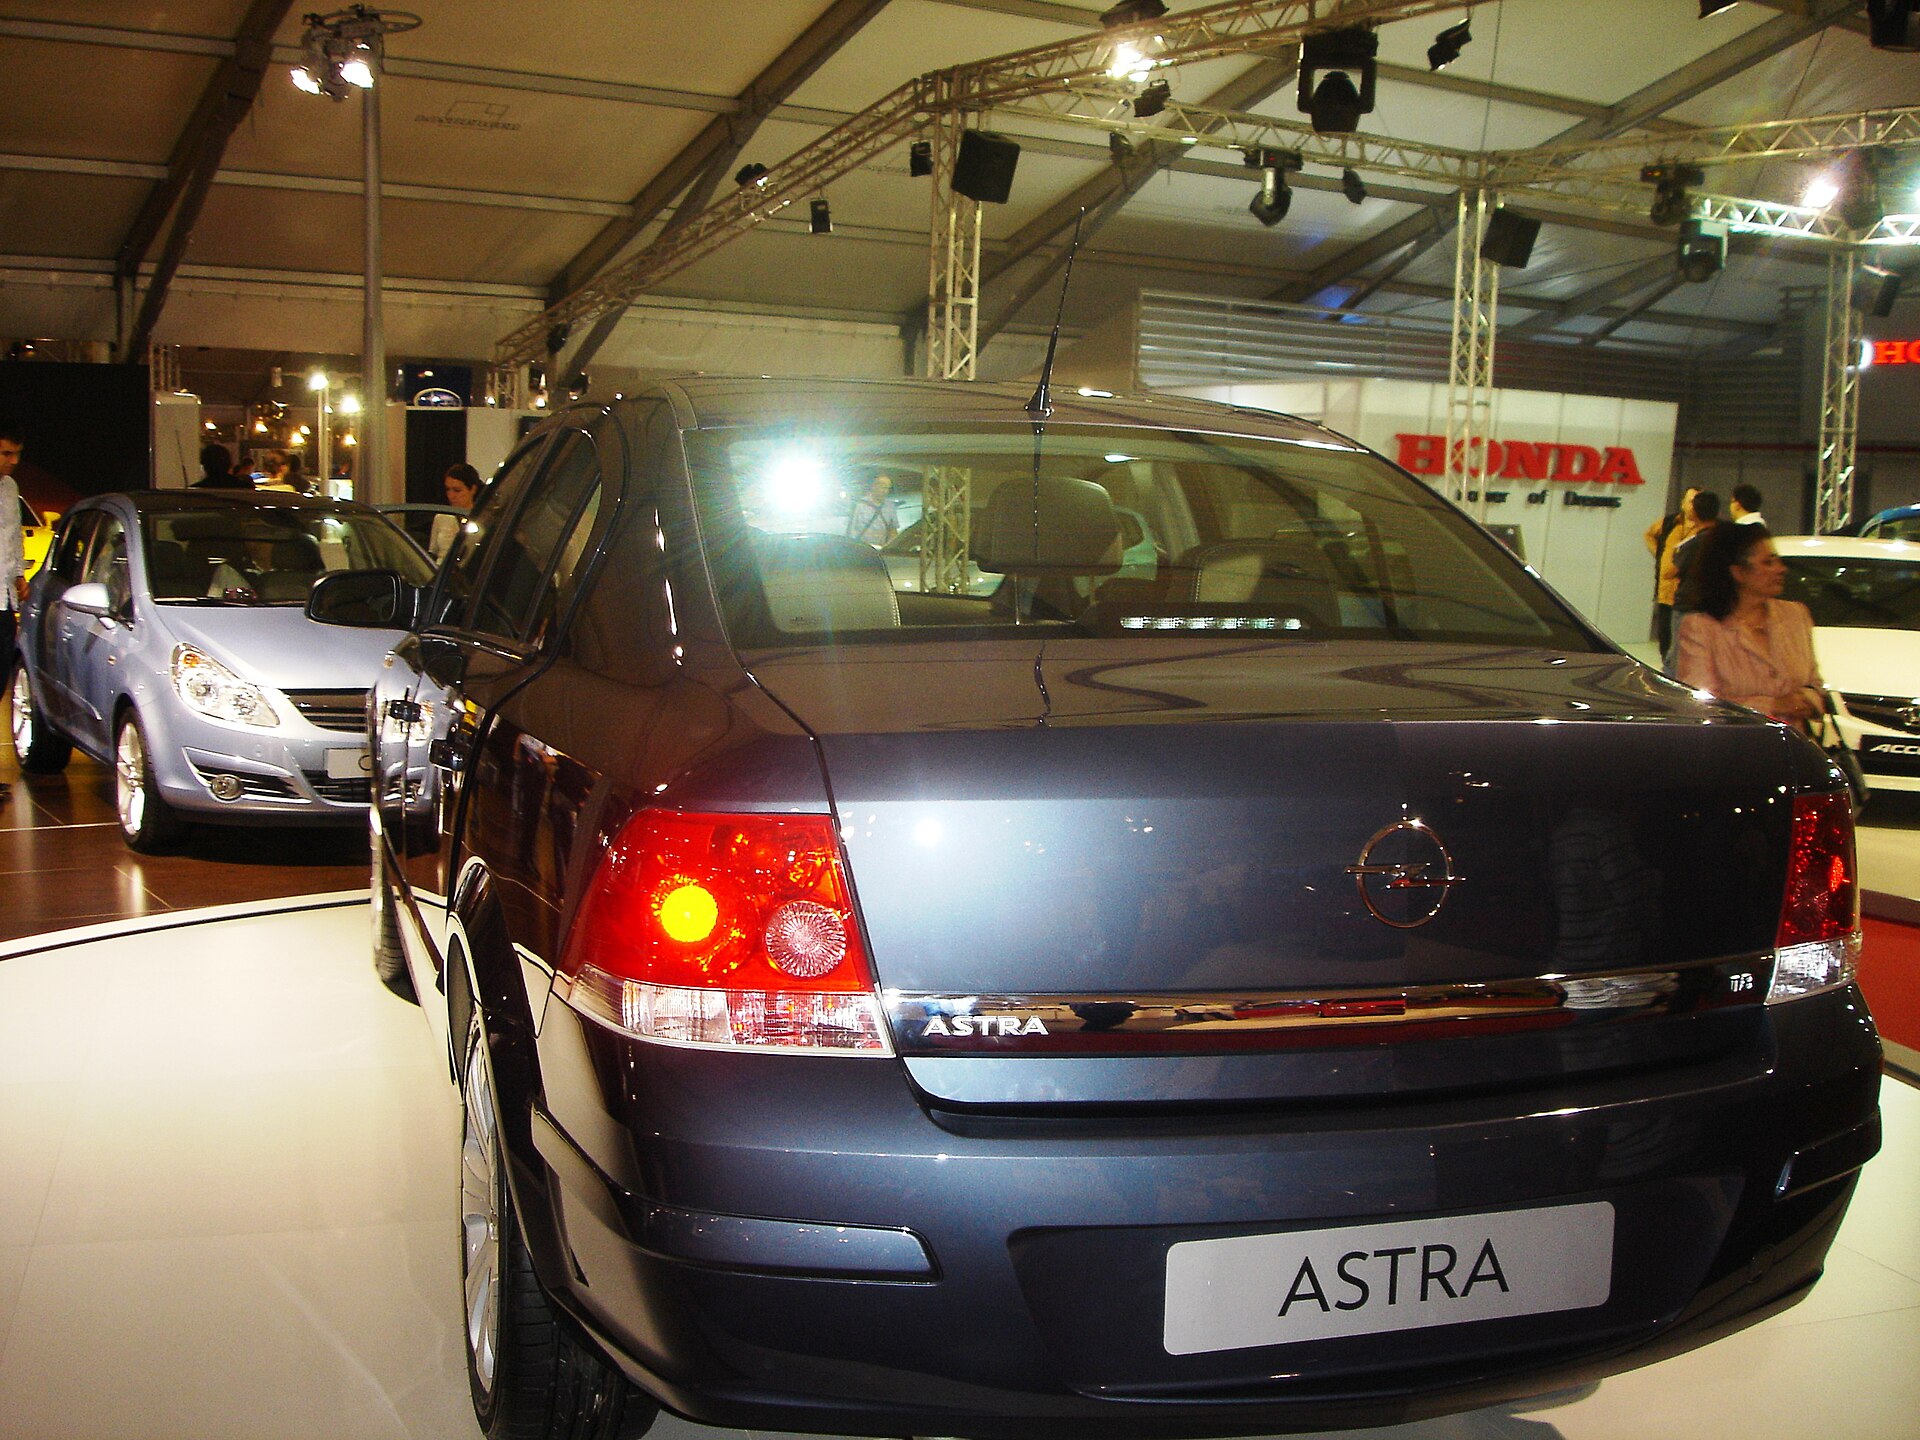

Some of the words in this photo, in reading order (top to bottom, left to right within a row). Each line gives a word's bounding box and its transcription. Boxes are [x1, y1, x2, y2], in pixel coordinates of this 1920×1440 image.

[1395, 433, 1645, 485] HONDA
[1870, 744, 1920, 755] ACC
[921, 1014, 1049, 1037] ASTRA
[1278, 1238, 1509, 1317] ASTRA
